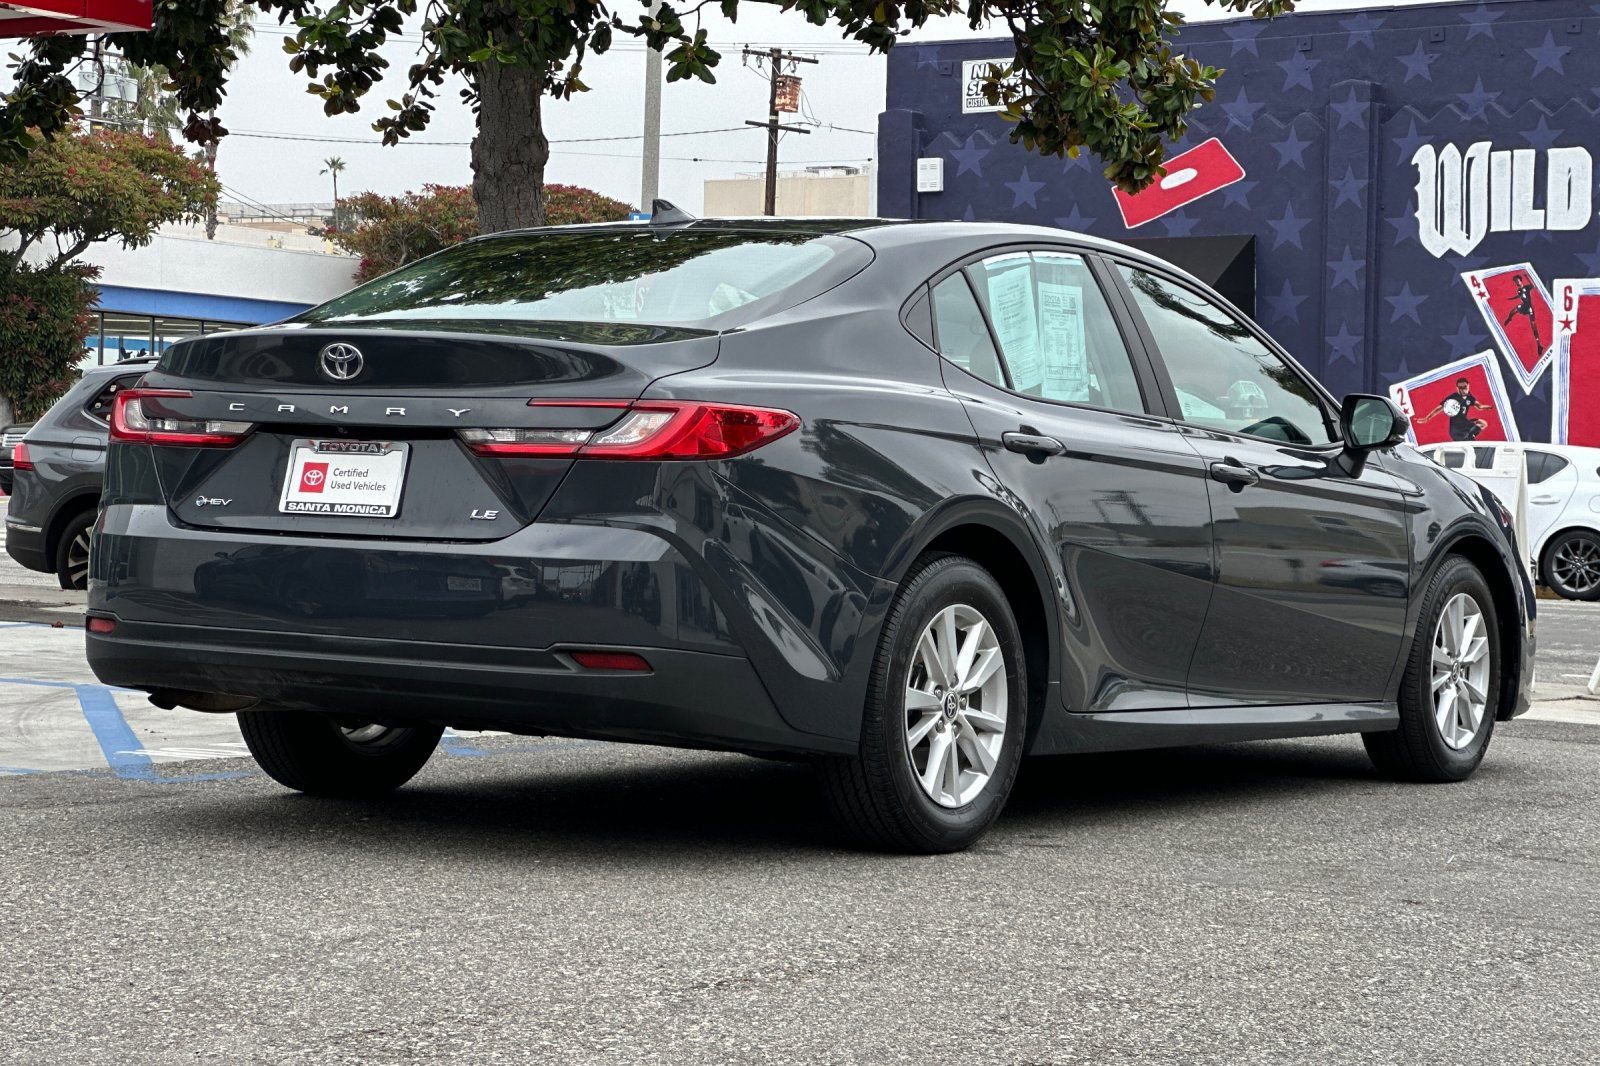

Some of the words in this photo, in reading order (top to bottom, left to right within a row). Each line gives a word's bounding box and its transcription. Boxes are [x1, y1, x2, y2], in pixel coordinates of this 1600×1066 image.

[1411, 141, 1593, 259] WILD
[1470, 274, 1481, 289] 4
[1563, 285, 1574, 312] 6
[1397, 387, 1407, 407] 2
[228, 402, 472, 418] CAMRY
[321, 443, 378, 452] TOYOTA
[333, 468, 369, 477] Certified
[331, 481, 351, 490] Used
[353, 481, 387, 491] Vehicles
[204, 498, 233, 506] HEV
[287, 502, 330, 512] SANTA
[334, 504, 387, 514] MONICA
[470, 509, 499, 520] LE
